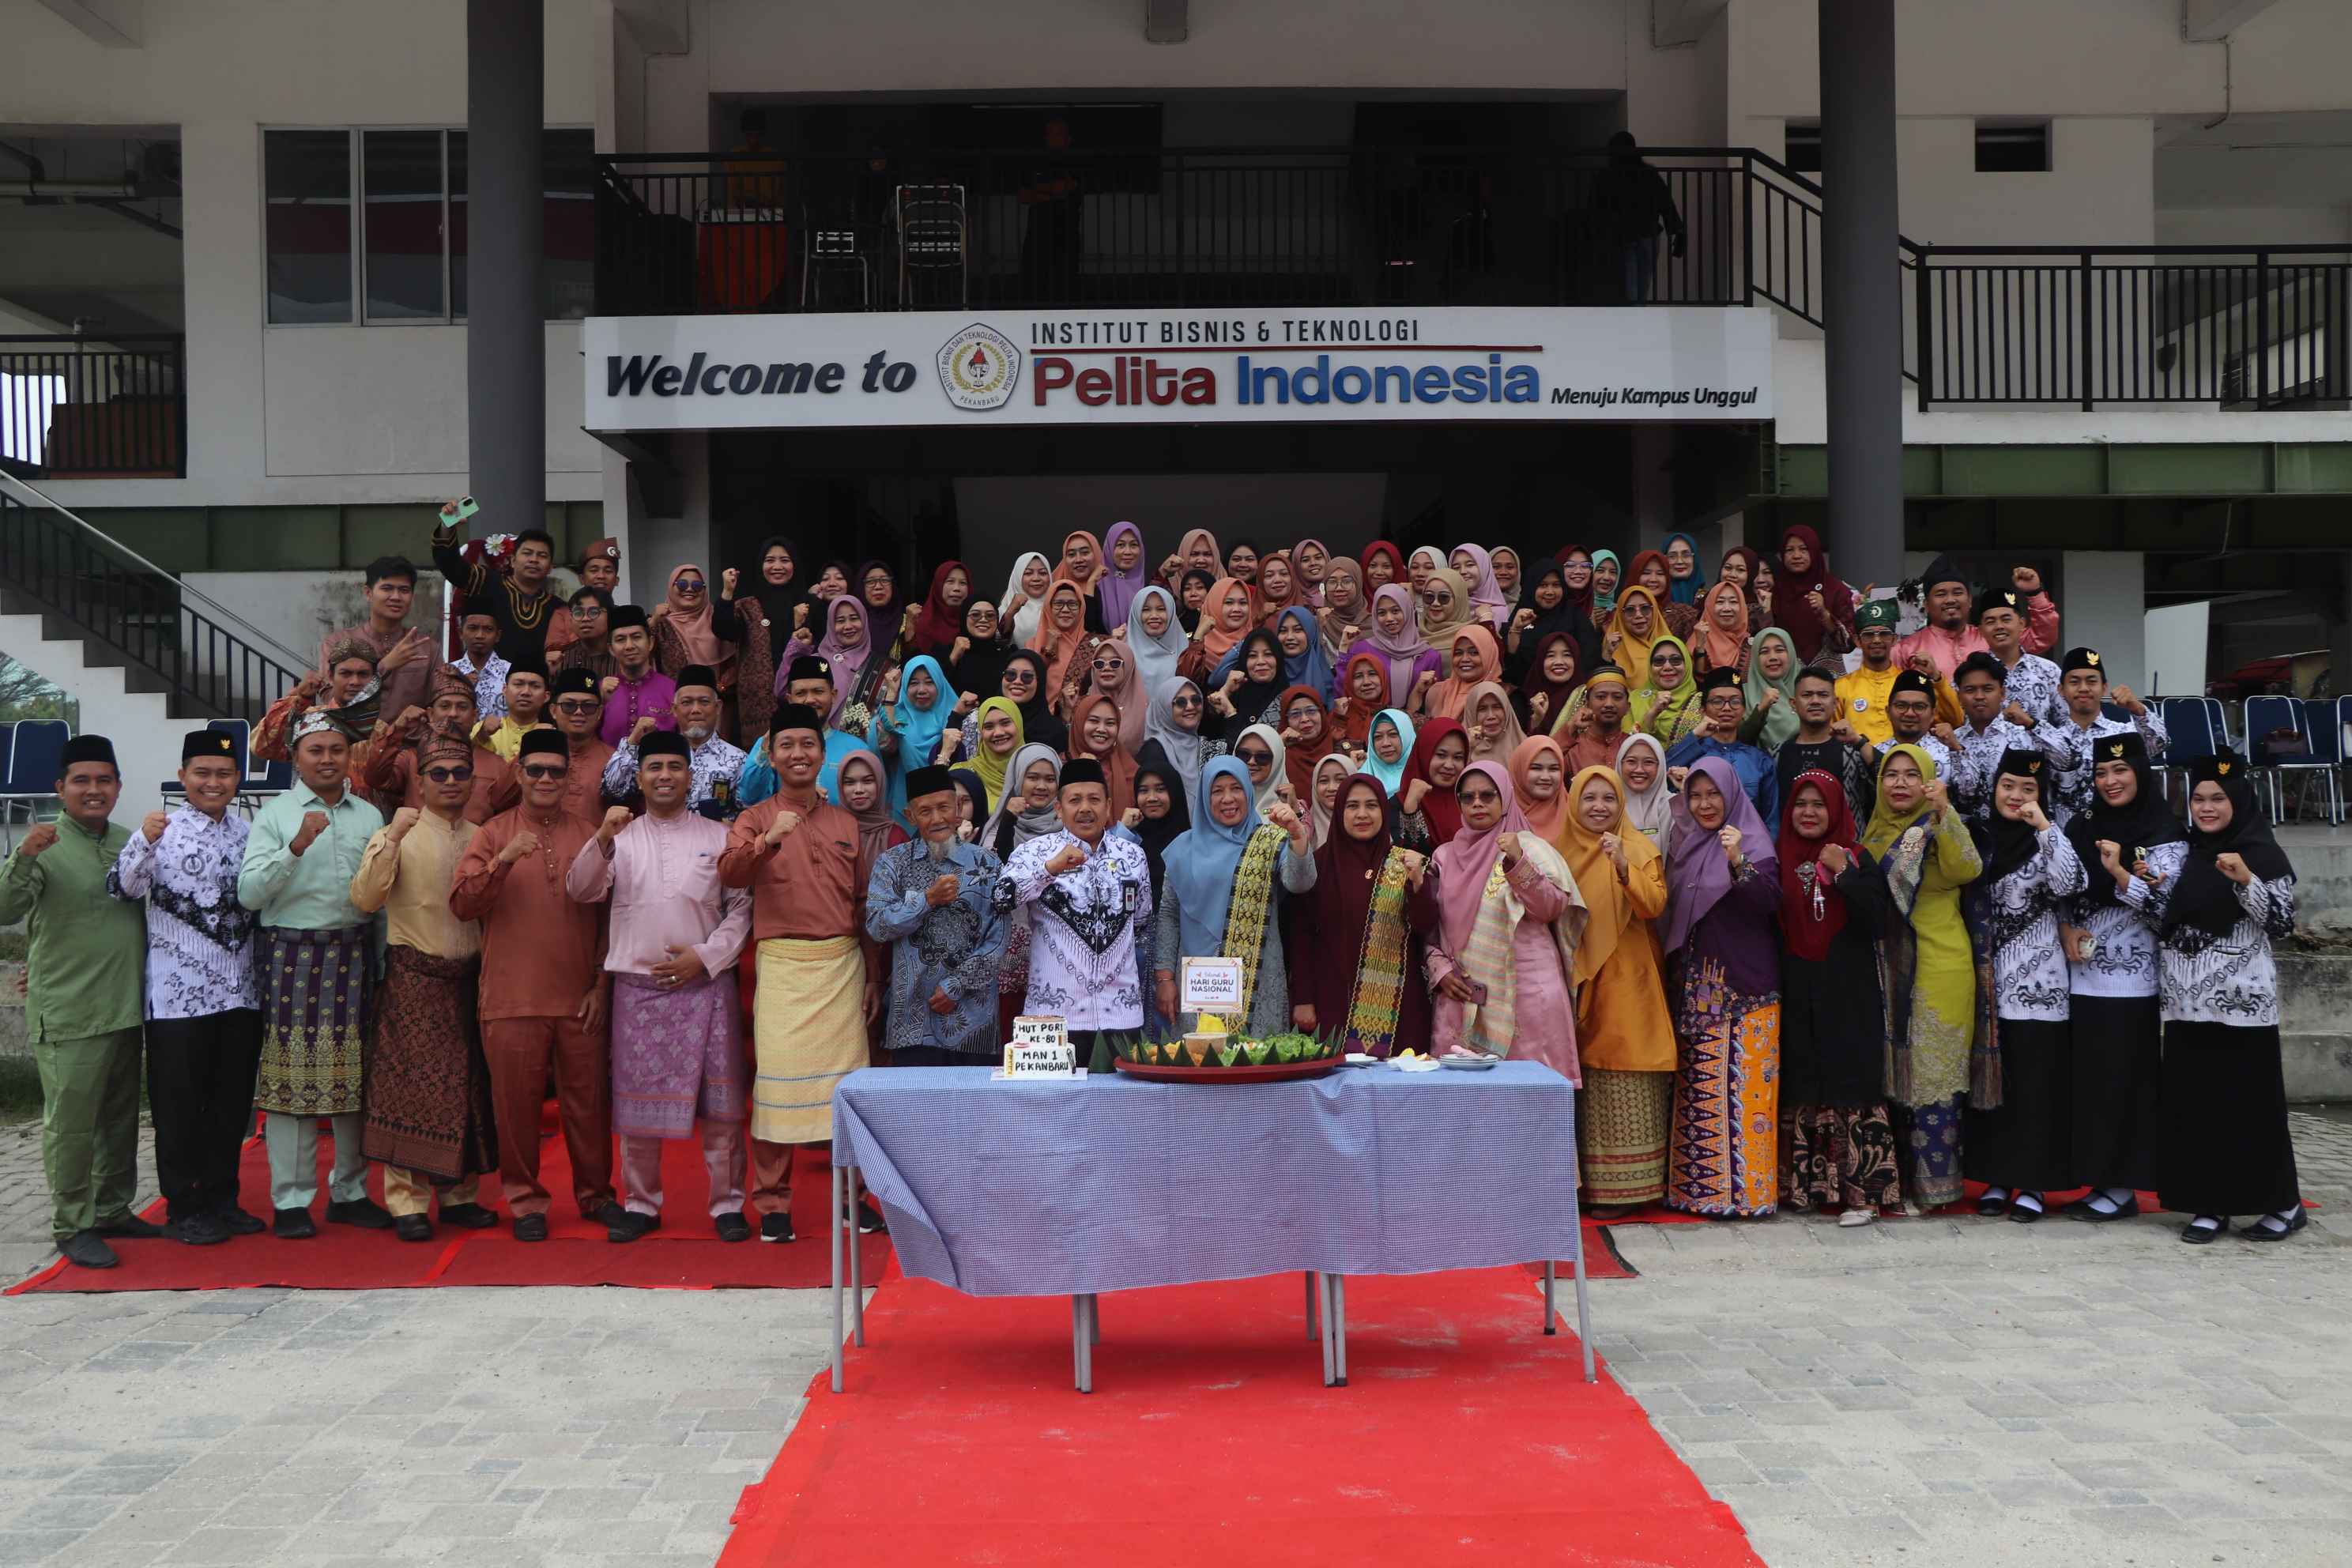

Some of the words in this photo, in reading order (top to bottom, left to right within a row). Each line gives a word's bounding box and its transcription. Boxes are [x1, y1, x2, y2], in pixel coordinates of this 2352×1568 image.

[1031, 322, 1149, 345] INSTITUT
[1160, 320, 1246, 344] BISNIS
[1257, 320, 1270, 343] &
[1281, 318, 1419, 343] TEKNOLOGI
[952, 336, 965, 349] DAN
[964, 330, 1000, 343] TEKNOLOGI
[607, 352, 846, 398] Welcome
[861, 349, 918, 394] to
[1033, 356, 1217, 407] Pelita
[1237, 353, 1540, 405] Indonesia
[959, 395, 1000, 405] PEKANBARU
[1551, 387, 1619, 408] Menuju
[1620, 387, 1690, 409] Kampus
[1694, 386, 1758, 408] Unggul
[1019, 1024, 1037, 1034] HUT
[1040, 1023, 1063, 1032] PGRI
[1030, 1035, 1056, 1043] KE-80
[1023, 1050, 1047, 1060] MAN
[1051, 1050, 1058, 1060] 1
[1015, 1061, 1069, 1071] PEKANBARU
